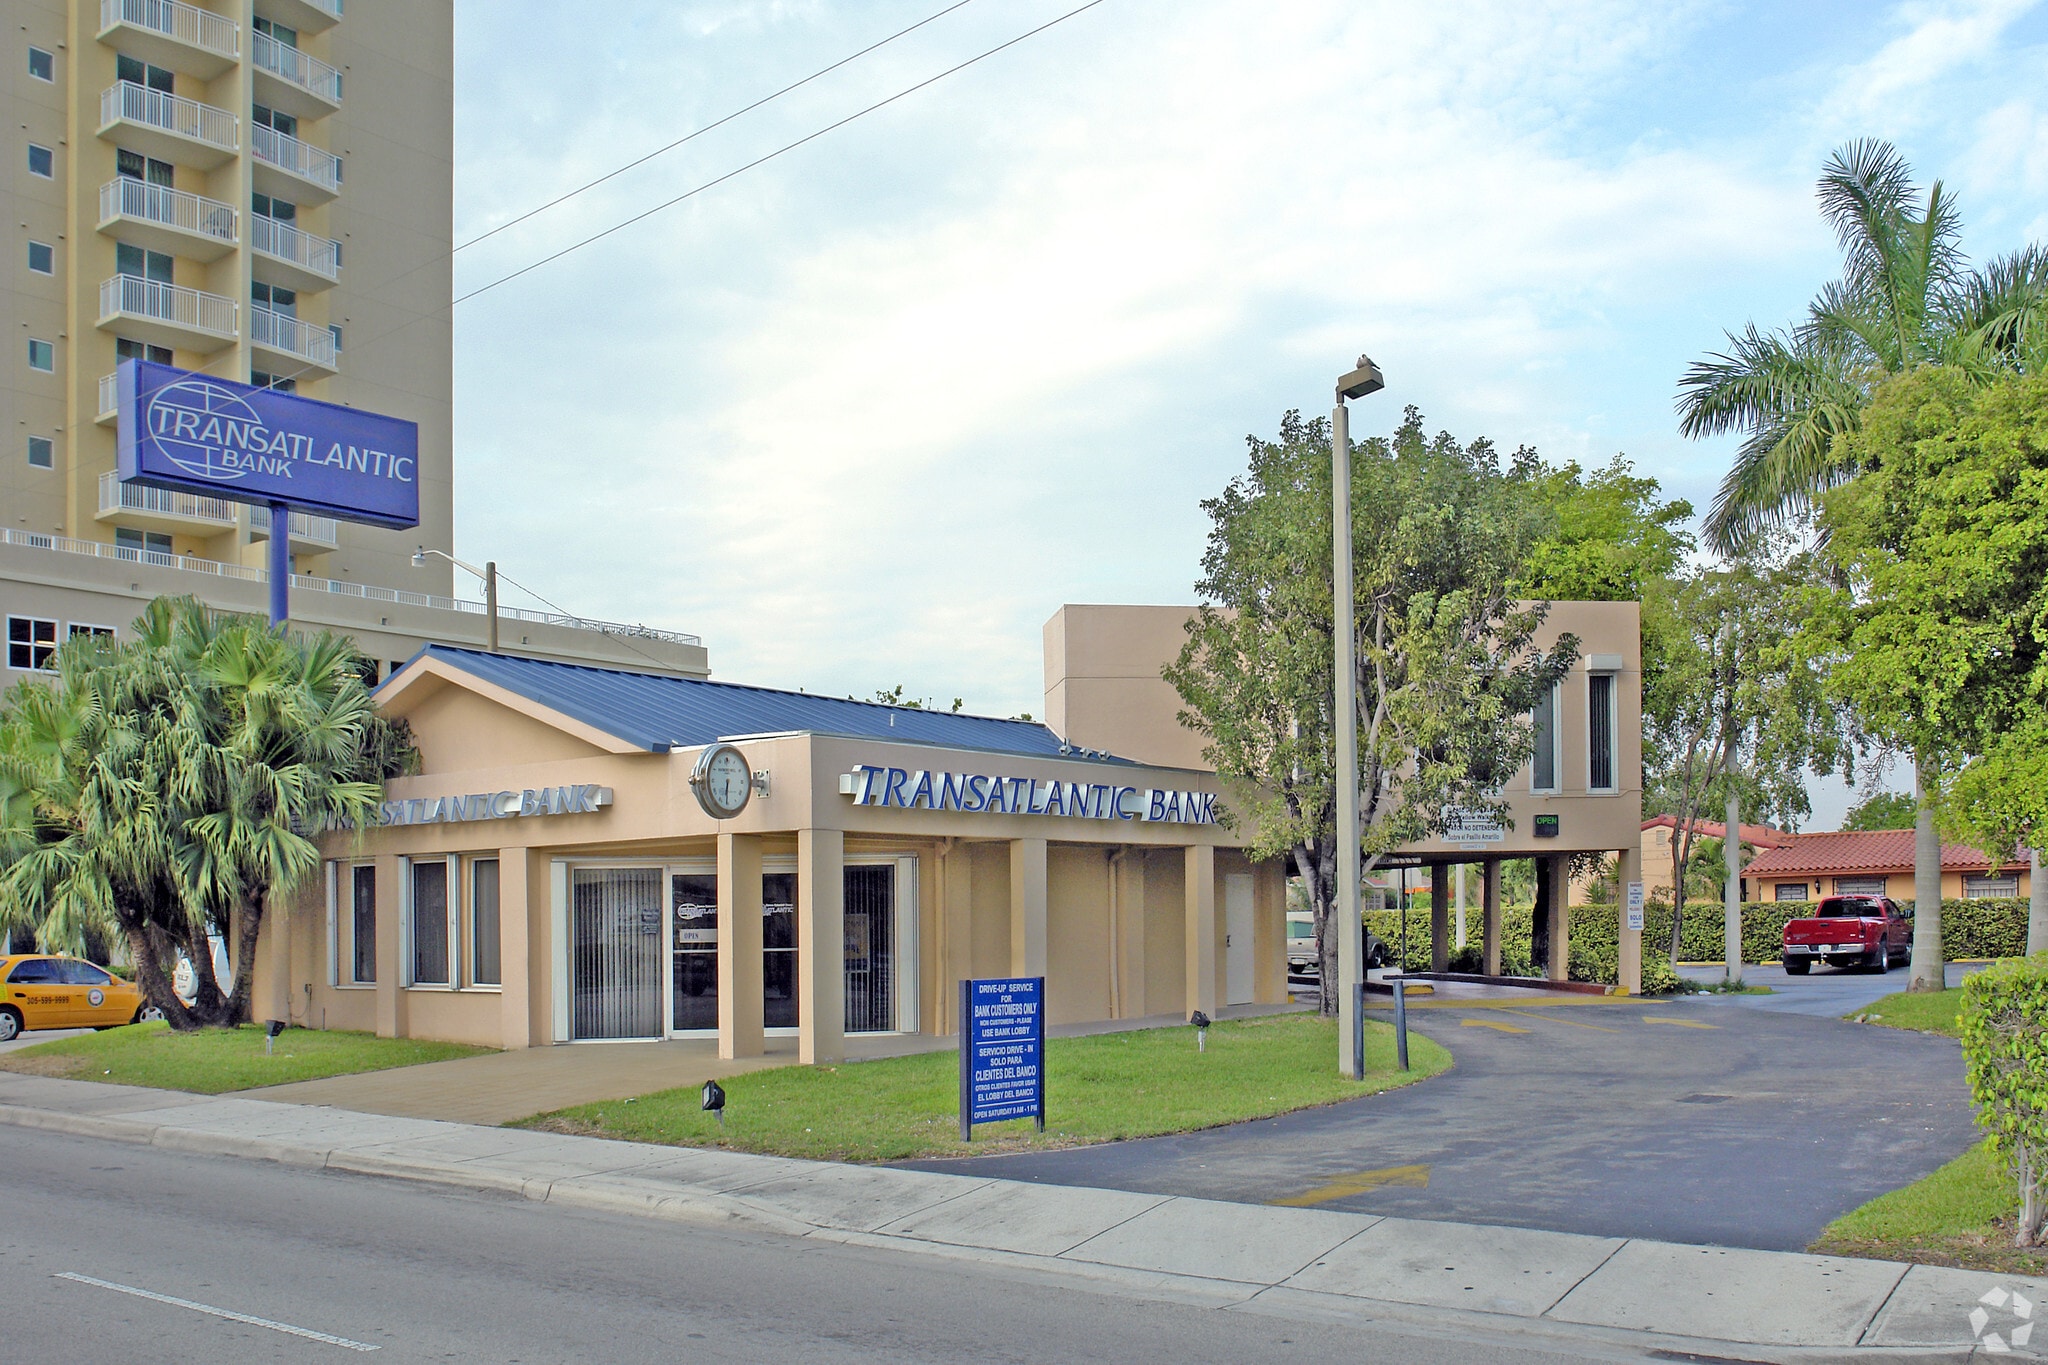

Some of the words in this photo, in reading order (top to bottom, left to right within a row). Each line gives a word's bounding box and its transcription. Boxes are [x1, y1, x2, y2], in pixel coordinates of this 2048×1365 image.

[153, 405, 414, 482] TRANSATLANTIC
[221, 449, 293, 479] BANK
[520, 784, 600, 817] BANK
[856, 764, 1137, 821] TRANSATLANTIC
[1147, 788, 1219, 825] BANK
[1536, 817, 1558, 825] OPEN
[979, 984, 1007, 994] DRIVE-UP
[1009, 983, 1034, 992] SERVICE
[1001, 995, 1012, 1003] FOR
[975, 1004, 990, 1018] BANK
[991, 1003, 1022, 1017] CUSTOMERS
[1024, 1002, 1038, 1015] ONLY
[982, 1029, 994, 1037] USE
[995, 1028, 1010, 1037] BANK
[1011, 1026, 1030, 1035] LOBBY
[979, 1047, 1006, 1057] SERVICIO
[1007, 1045, 1024, 1054] DRIVE
[1028, 1044, 1034, 1052] IN
[990, 1057, 1007, 1066] SOLO
[1007, 1056, 1023, 1065] PARA
[975, 1068, 1003, 1082] CLIENTES
[1004, 1067, 1015, 1079] DEL
[1016, 1065, 1036, 1078] BANCO
[978, 1093, 985, 1102] EL
[985, 1091, 1004, 1101] LOBBY
[1004, 1090, 1015, 1099] DEL
[1015, 1088, 1034, 1097] BANCO
[974, 1110, 987, 1119] OPEN
[988, 1107, 1012, 1117] SATURDAY
[1017, 1105, 1024, 1113] AM
[1031, 1104, 1038, 1112] PM
